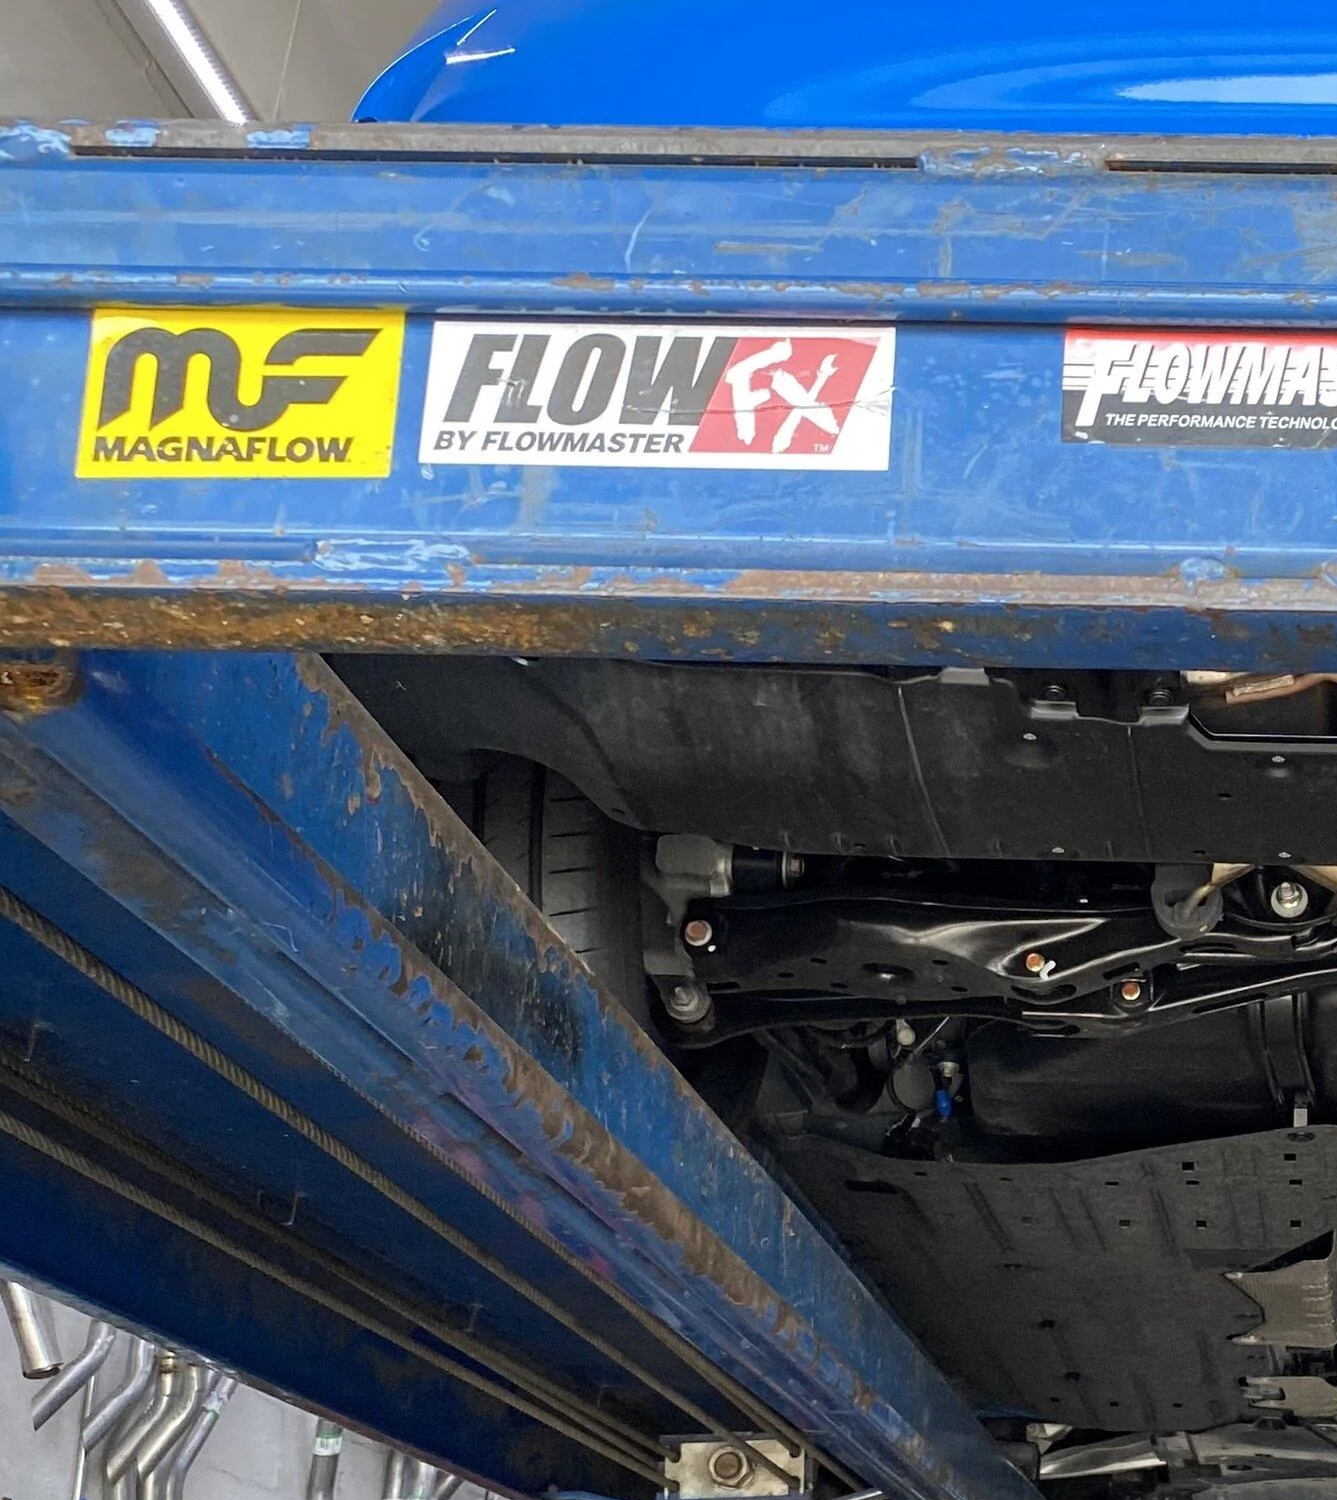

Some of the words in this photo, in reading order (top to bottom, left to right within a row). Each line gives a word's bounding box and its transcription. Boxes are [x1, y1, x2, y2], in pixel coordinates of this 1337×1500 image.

[443, 333, 736, 425] FLOW
[1105, 412, 1136, 427] THE
[1137, 413, 1257, 430] PERFORMANCE
[93, 436, 352, 464] MAGNAFLOW
[433, 430, 474, 452] BY
[481, 432, 685, 454] FLOWMASTER
